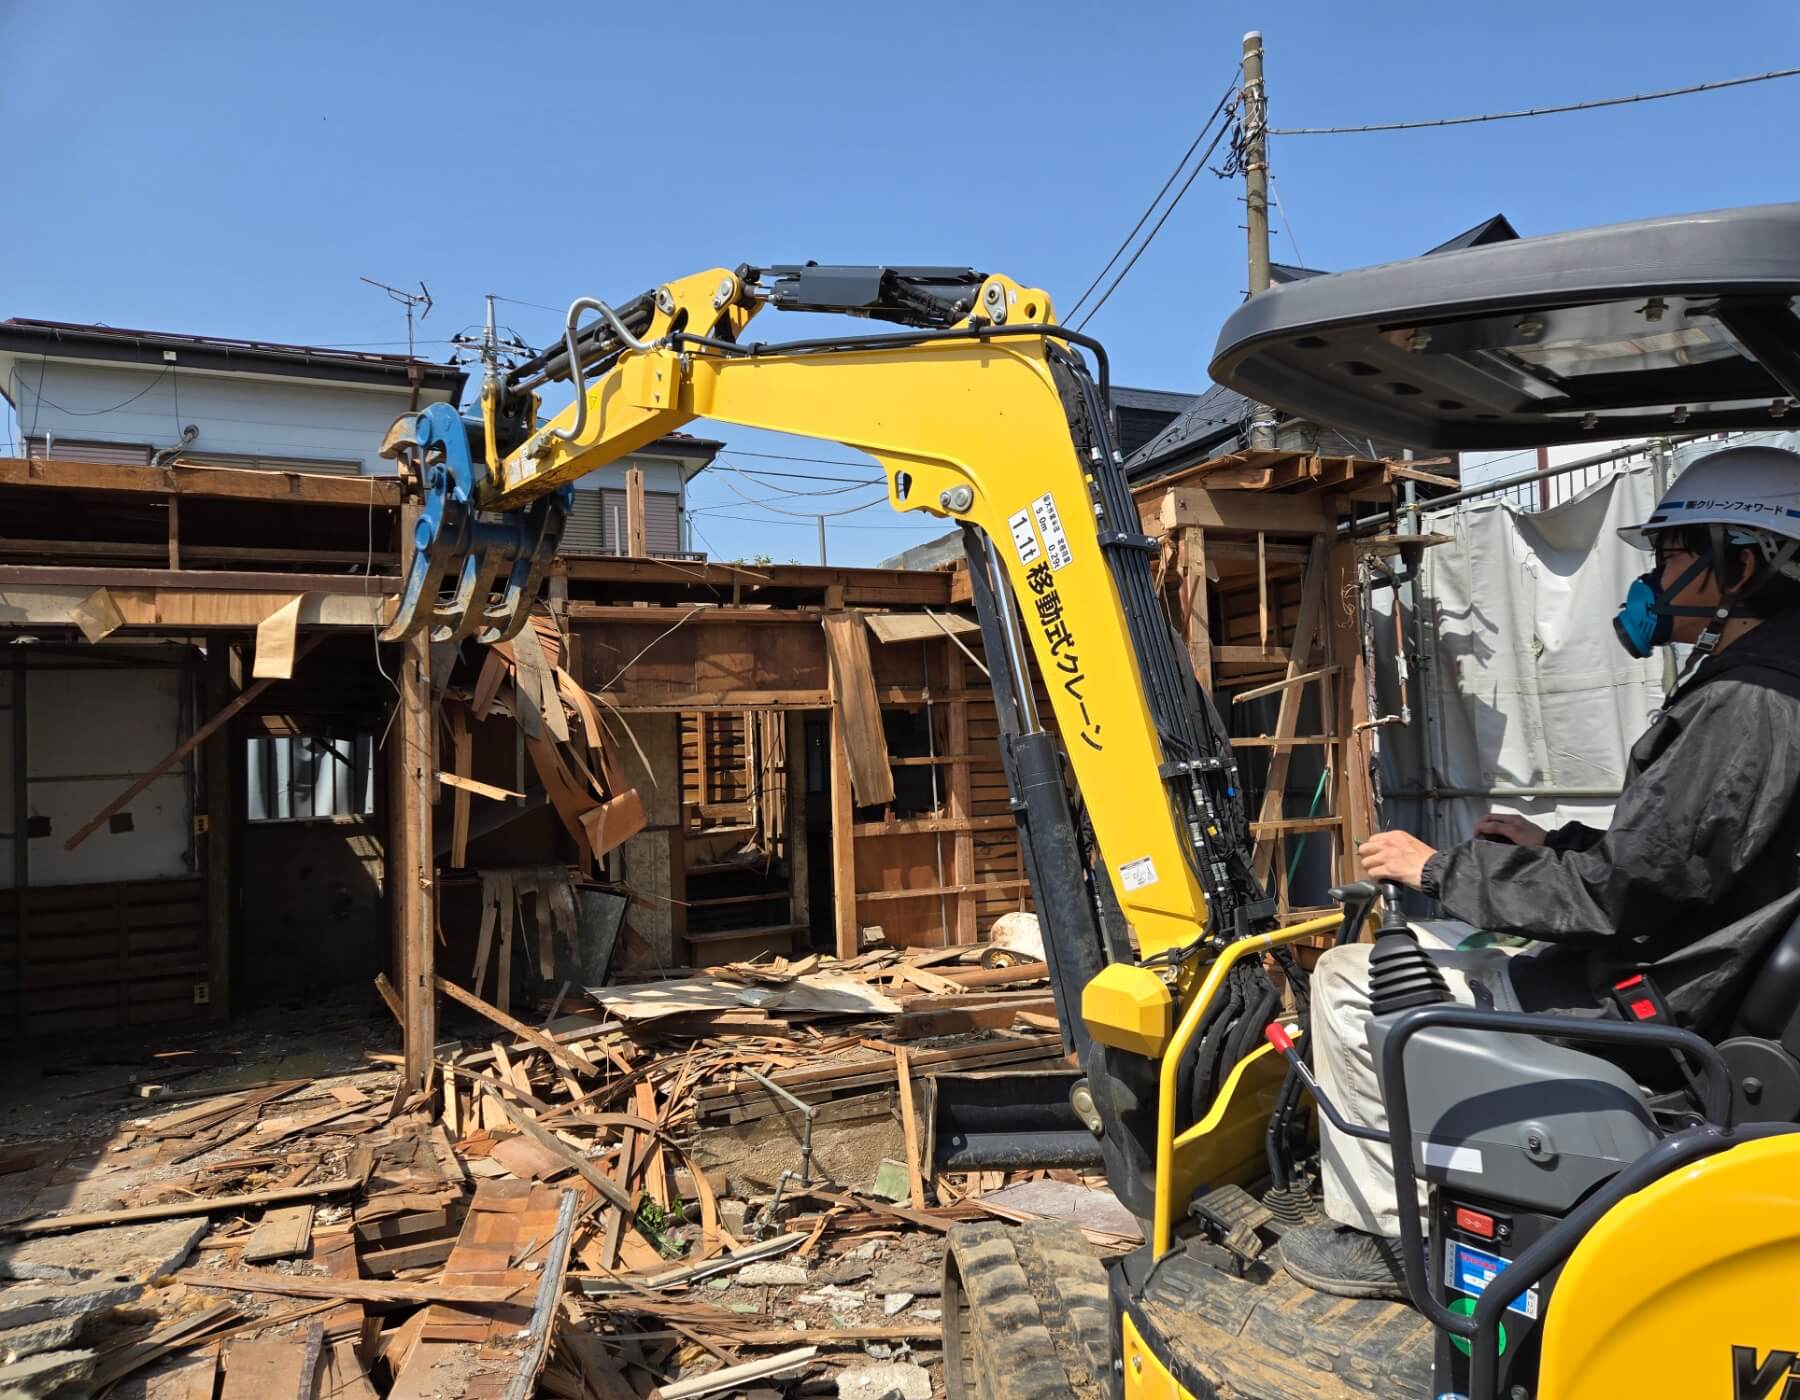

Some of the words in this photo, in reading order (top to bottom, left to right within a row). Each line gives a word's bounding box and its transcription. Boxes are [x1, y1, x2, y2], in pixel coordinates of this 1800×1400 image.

[1013, 517, 1037, 561] 1.1t
[1026, 561, 1103, 751] 移動式クレーン
